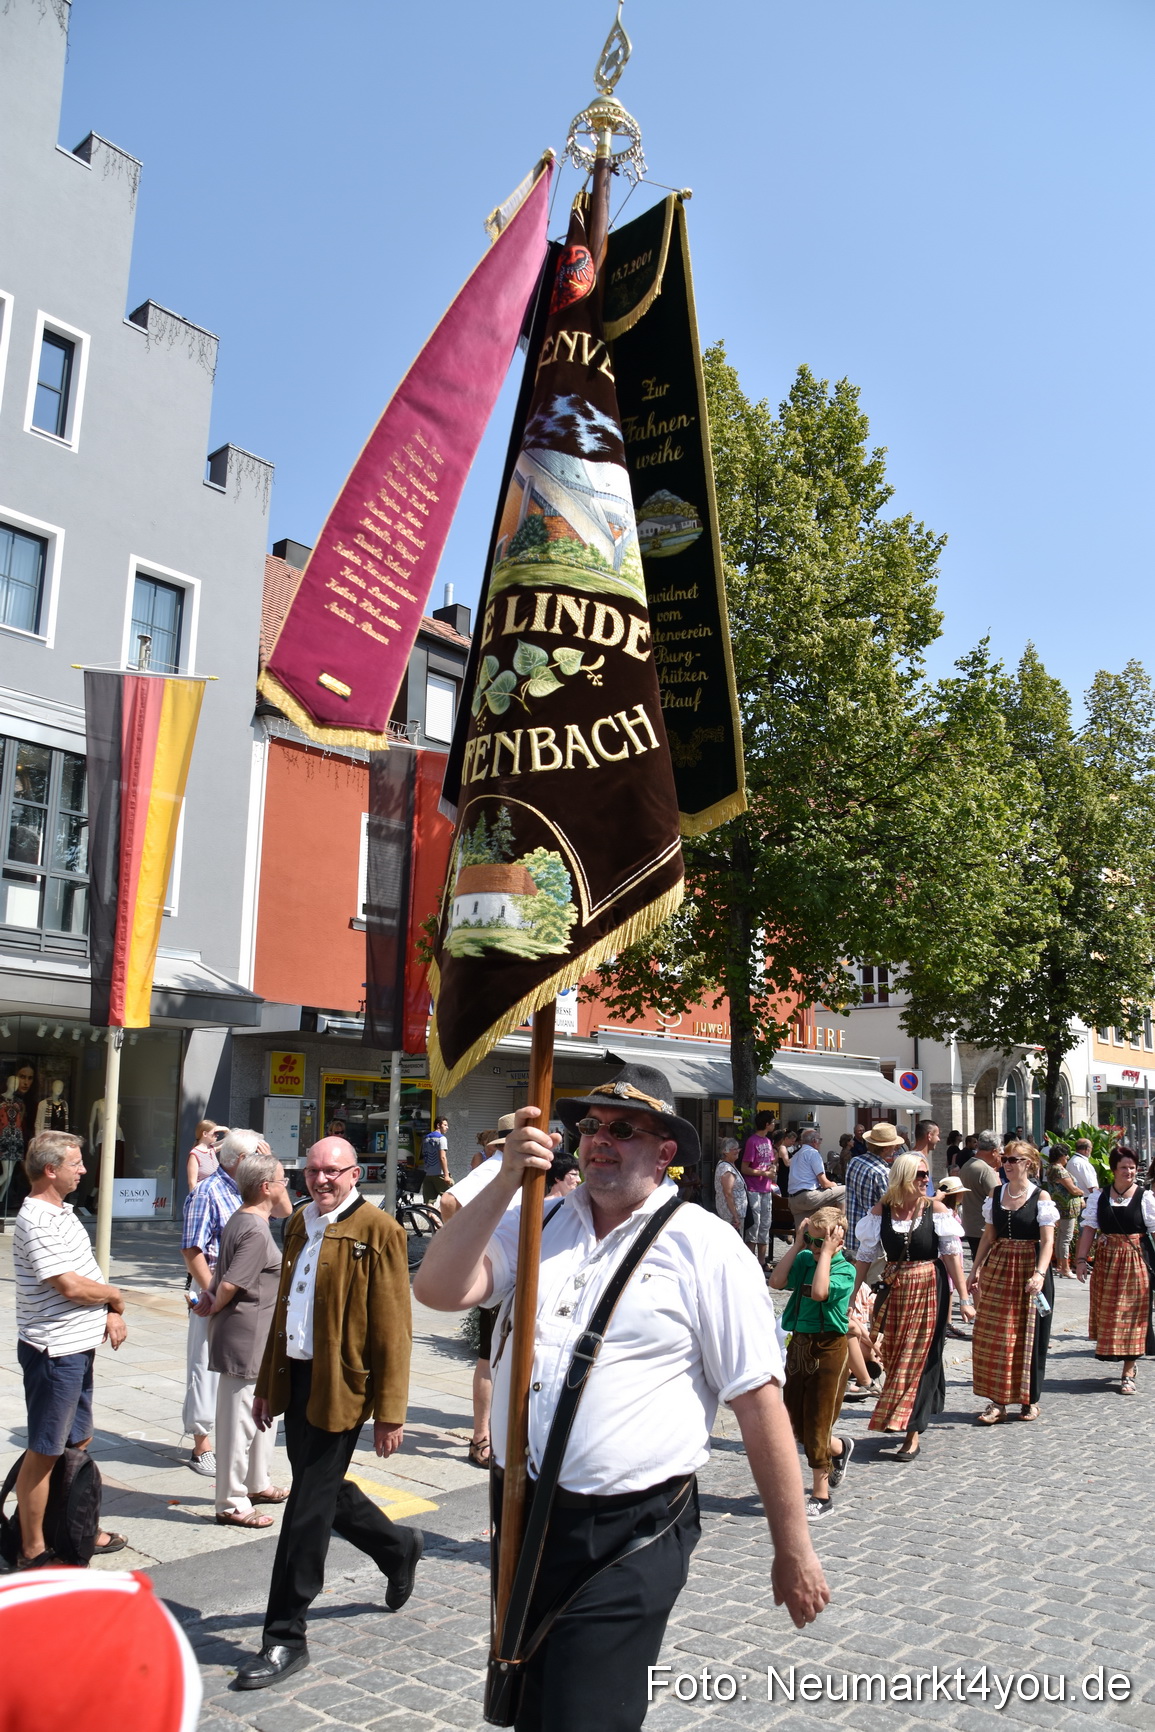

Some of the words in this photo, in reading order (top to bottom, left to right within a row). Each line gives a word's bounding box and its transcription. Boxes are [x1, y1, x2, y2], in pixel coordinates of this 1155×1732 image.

[641, 376, 671, 401] Zur
[636, 435, 685, 469] weihe
[656, 609, 682, 622] vom
[500, 592, 652, 662] LINDE
[653, 645, 701, 667] Burg-
[658, 667, 709, 684] hützen
[273, 1075, 301, 1086] LOTTO
[119, 1189, 150, 1197] SEASON
